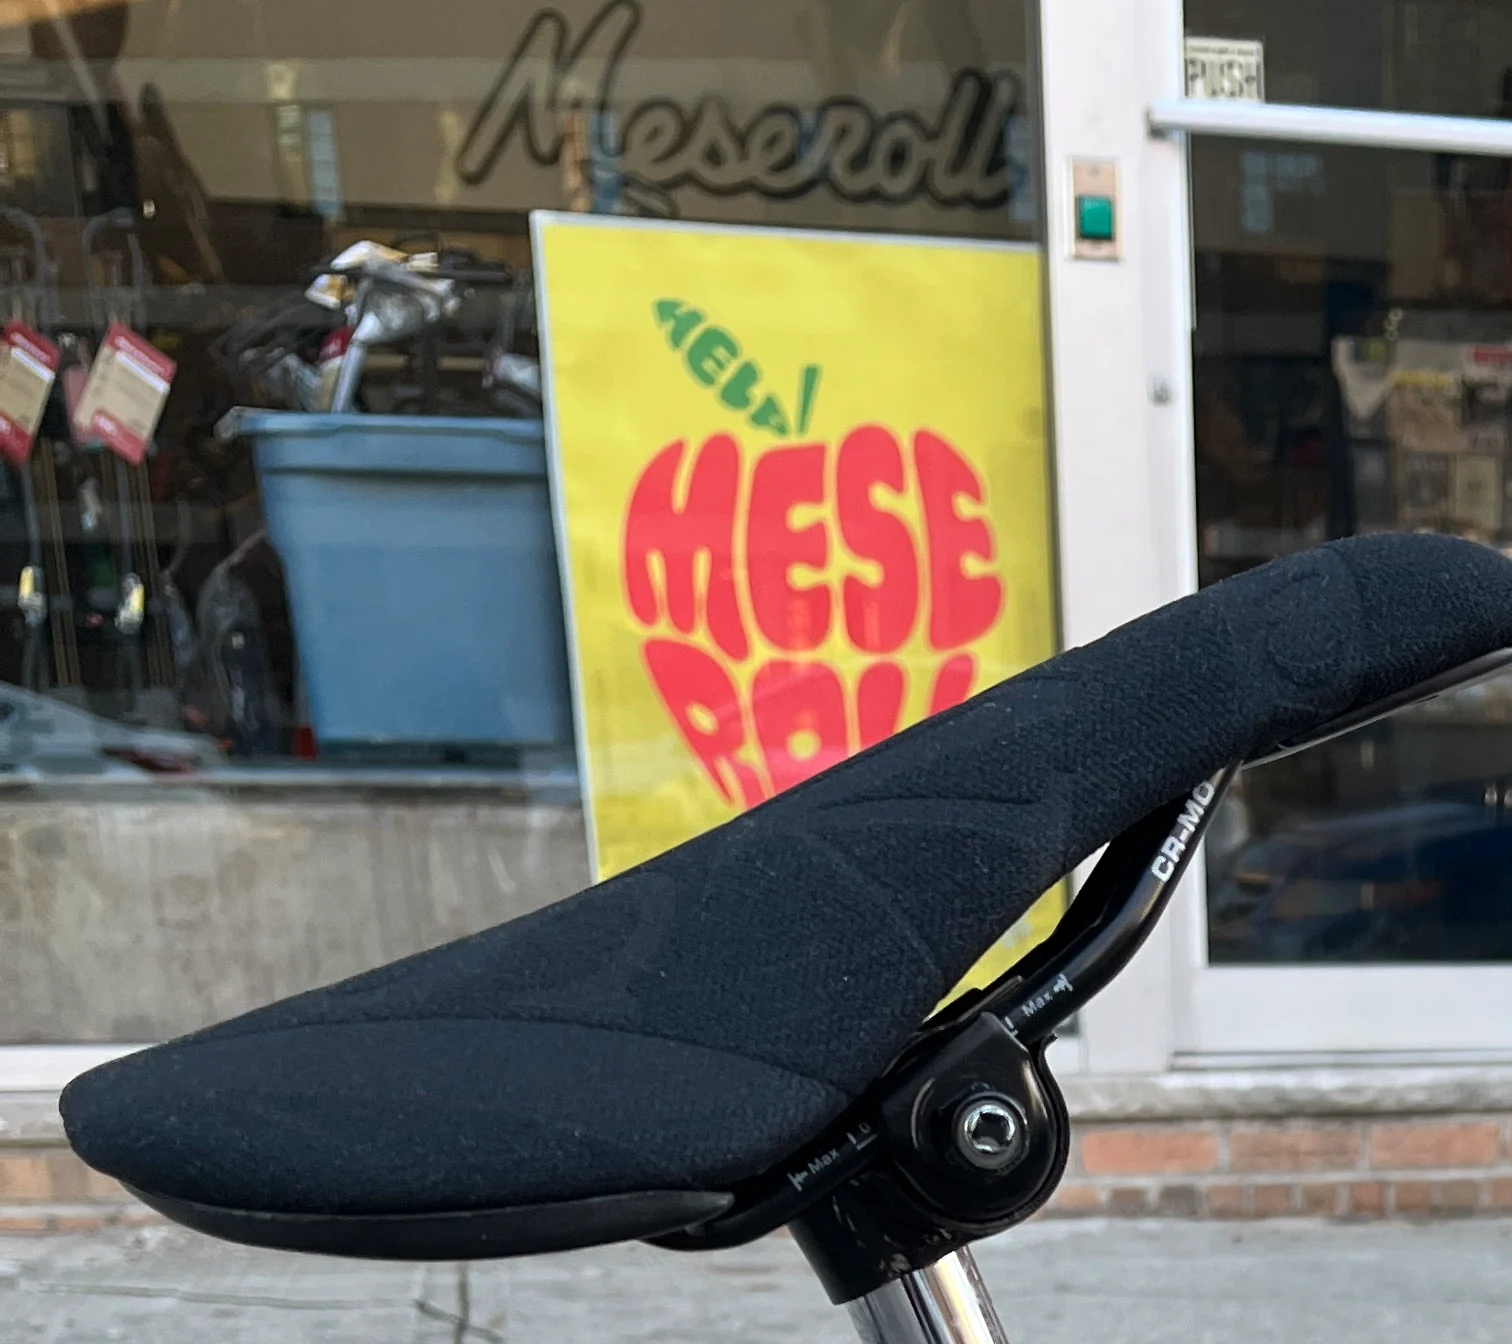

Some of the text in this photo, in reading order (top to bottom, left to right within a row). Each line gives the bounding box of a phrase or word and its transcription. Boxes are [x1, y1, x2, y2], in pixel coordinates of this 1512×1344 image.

[457, 0, 1022, 210] Meseroll
[1184, 58, 1263, 98] PUSH
[623, 423, 1004, 663] MESE
[1151, 781, 1215, 882] CR-MO
